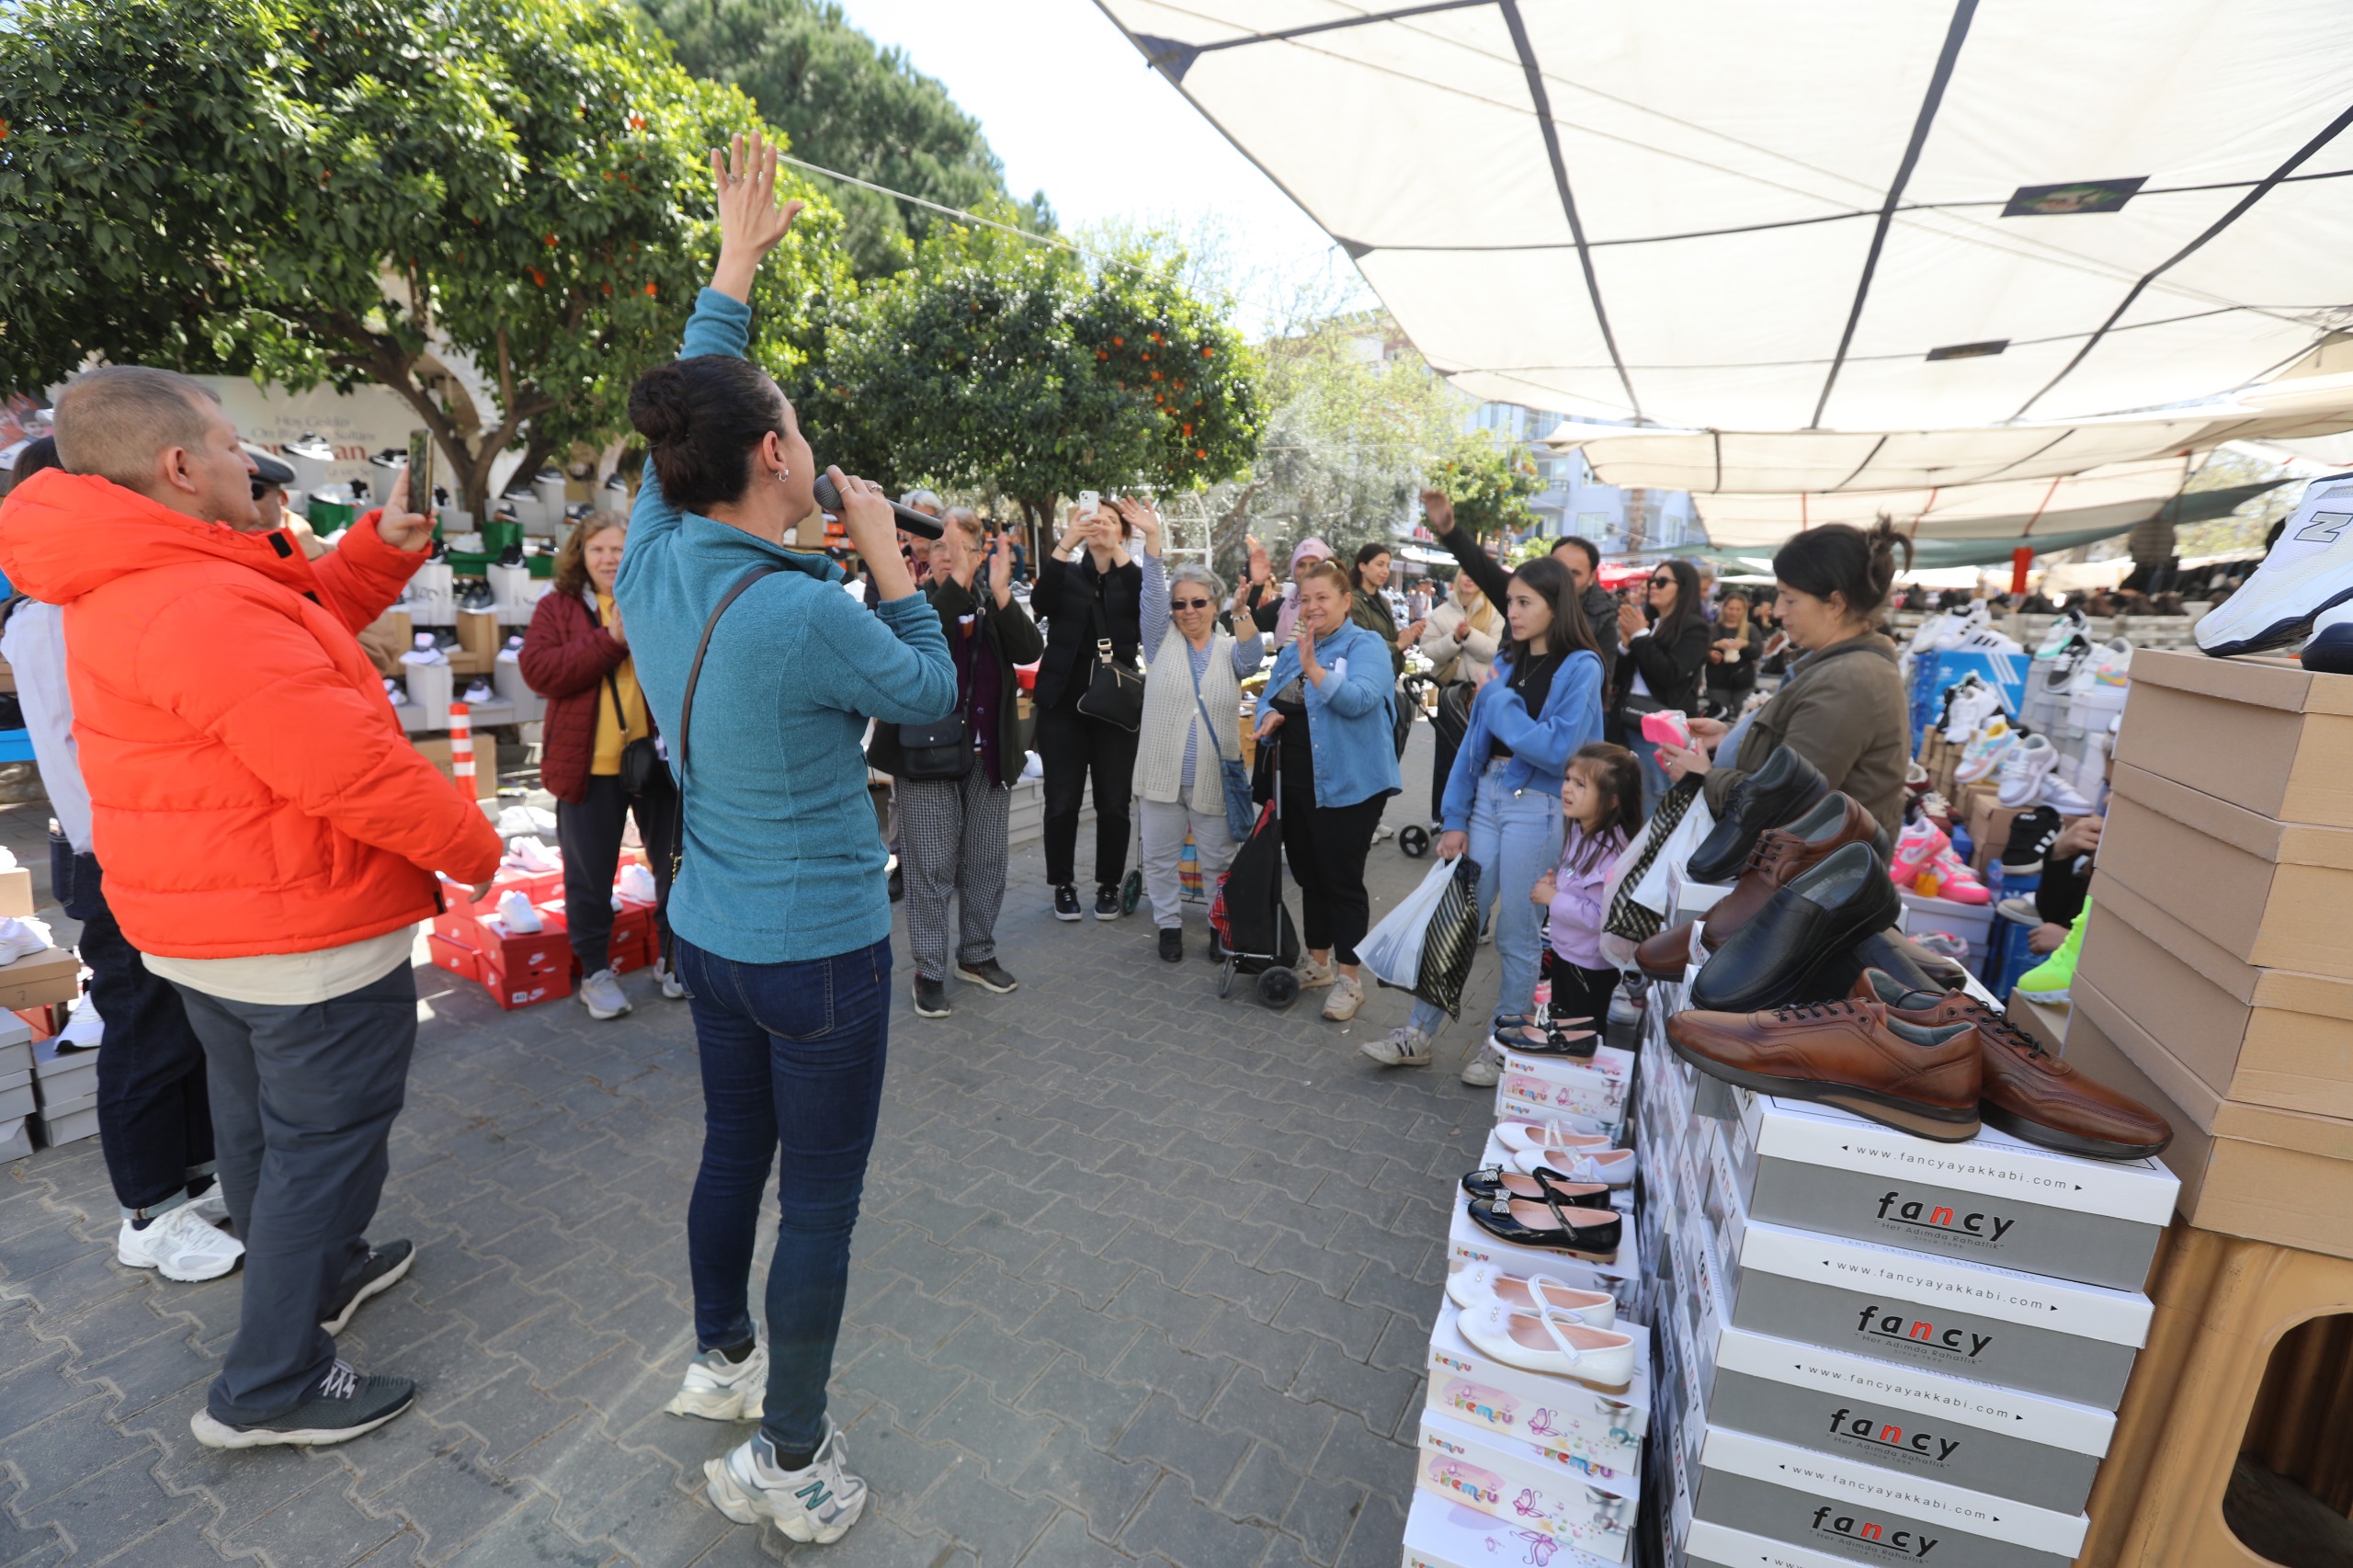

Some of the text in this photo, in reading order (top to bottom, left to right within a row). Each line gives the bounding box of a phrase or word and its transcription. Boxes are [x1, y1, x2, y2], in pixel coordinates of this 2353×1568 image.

[1857, 1146, 2067, 1190] www.fancyayakkabi.com
[1876, 1191, 2016, 1242] fancy
[1698, 1250, 1714, 1317] fancy
[1837, 1262, 2042, 1310] www.fancyayakkabi.com
[1858, 1305, 1993, 1357] fancy
[1685, 1341, 1699, 1412] fancy
[1809, 1365, 2008, 1419] www.fancyayakkabi.com
[1674, 1423, 1686, 1498] fancy
[1829, 1408, 1961, 1461] fancy
[1792, 1466, 1986, 1520] www.fancyayakkabi.com
[1812, 1506, 1938, 1558] fancy
